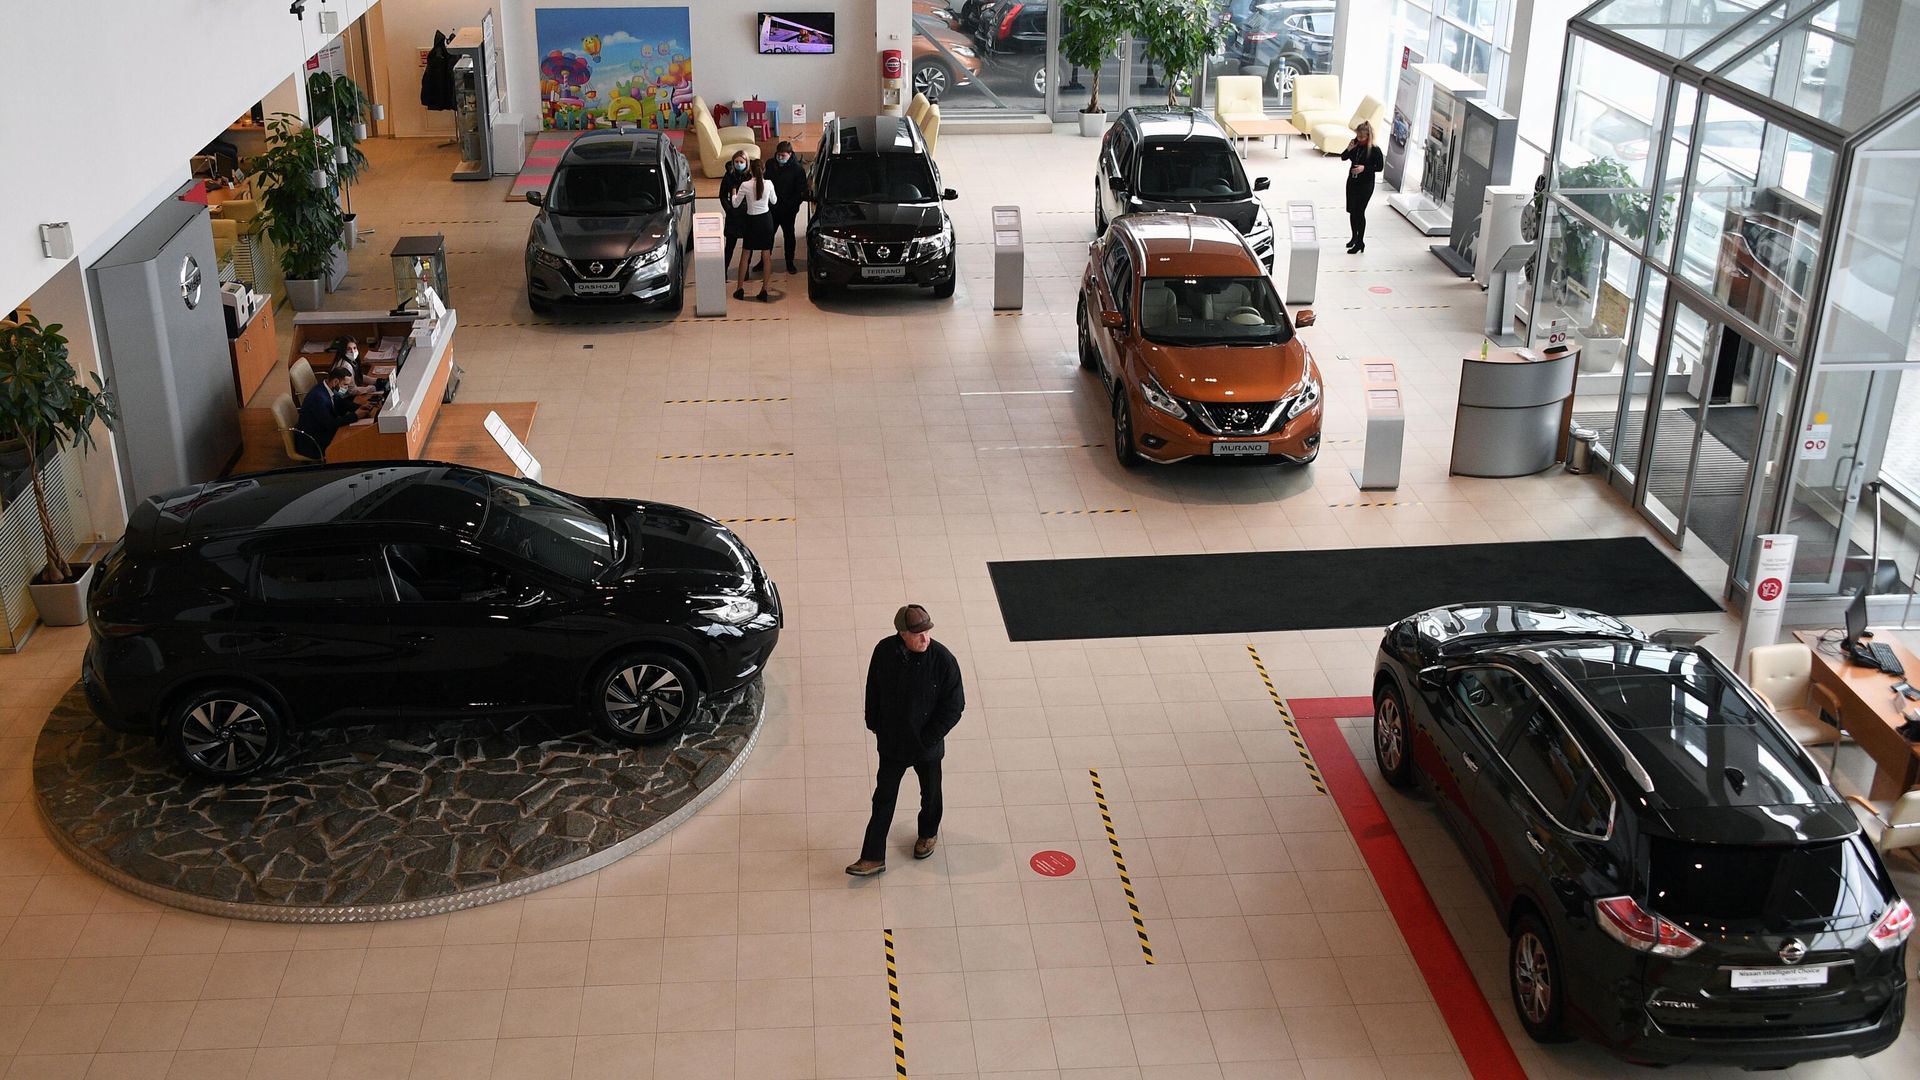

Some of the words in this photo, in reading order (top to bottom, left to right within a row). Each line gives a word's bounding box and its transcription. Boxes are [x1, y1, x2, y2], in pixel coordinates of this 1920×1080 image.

[1220, 444, 1262, 452] MURANO
[1738, 969, 1761, 977] Nissan
[1798, 967, 1820, 975] Choice
